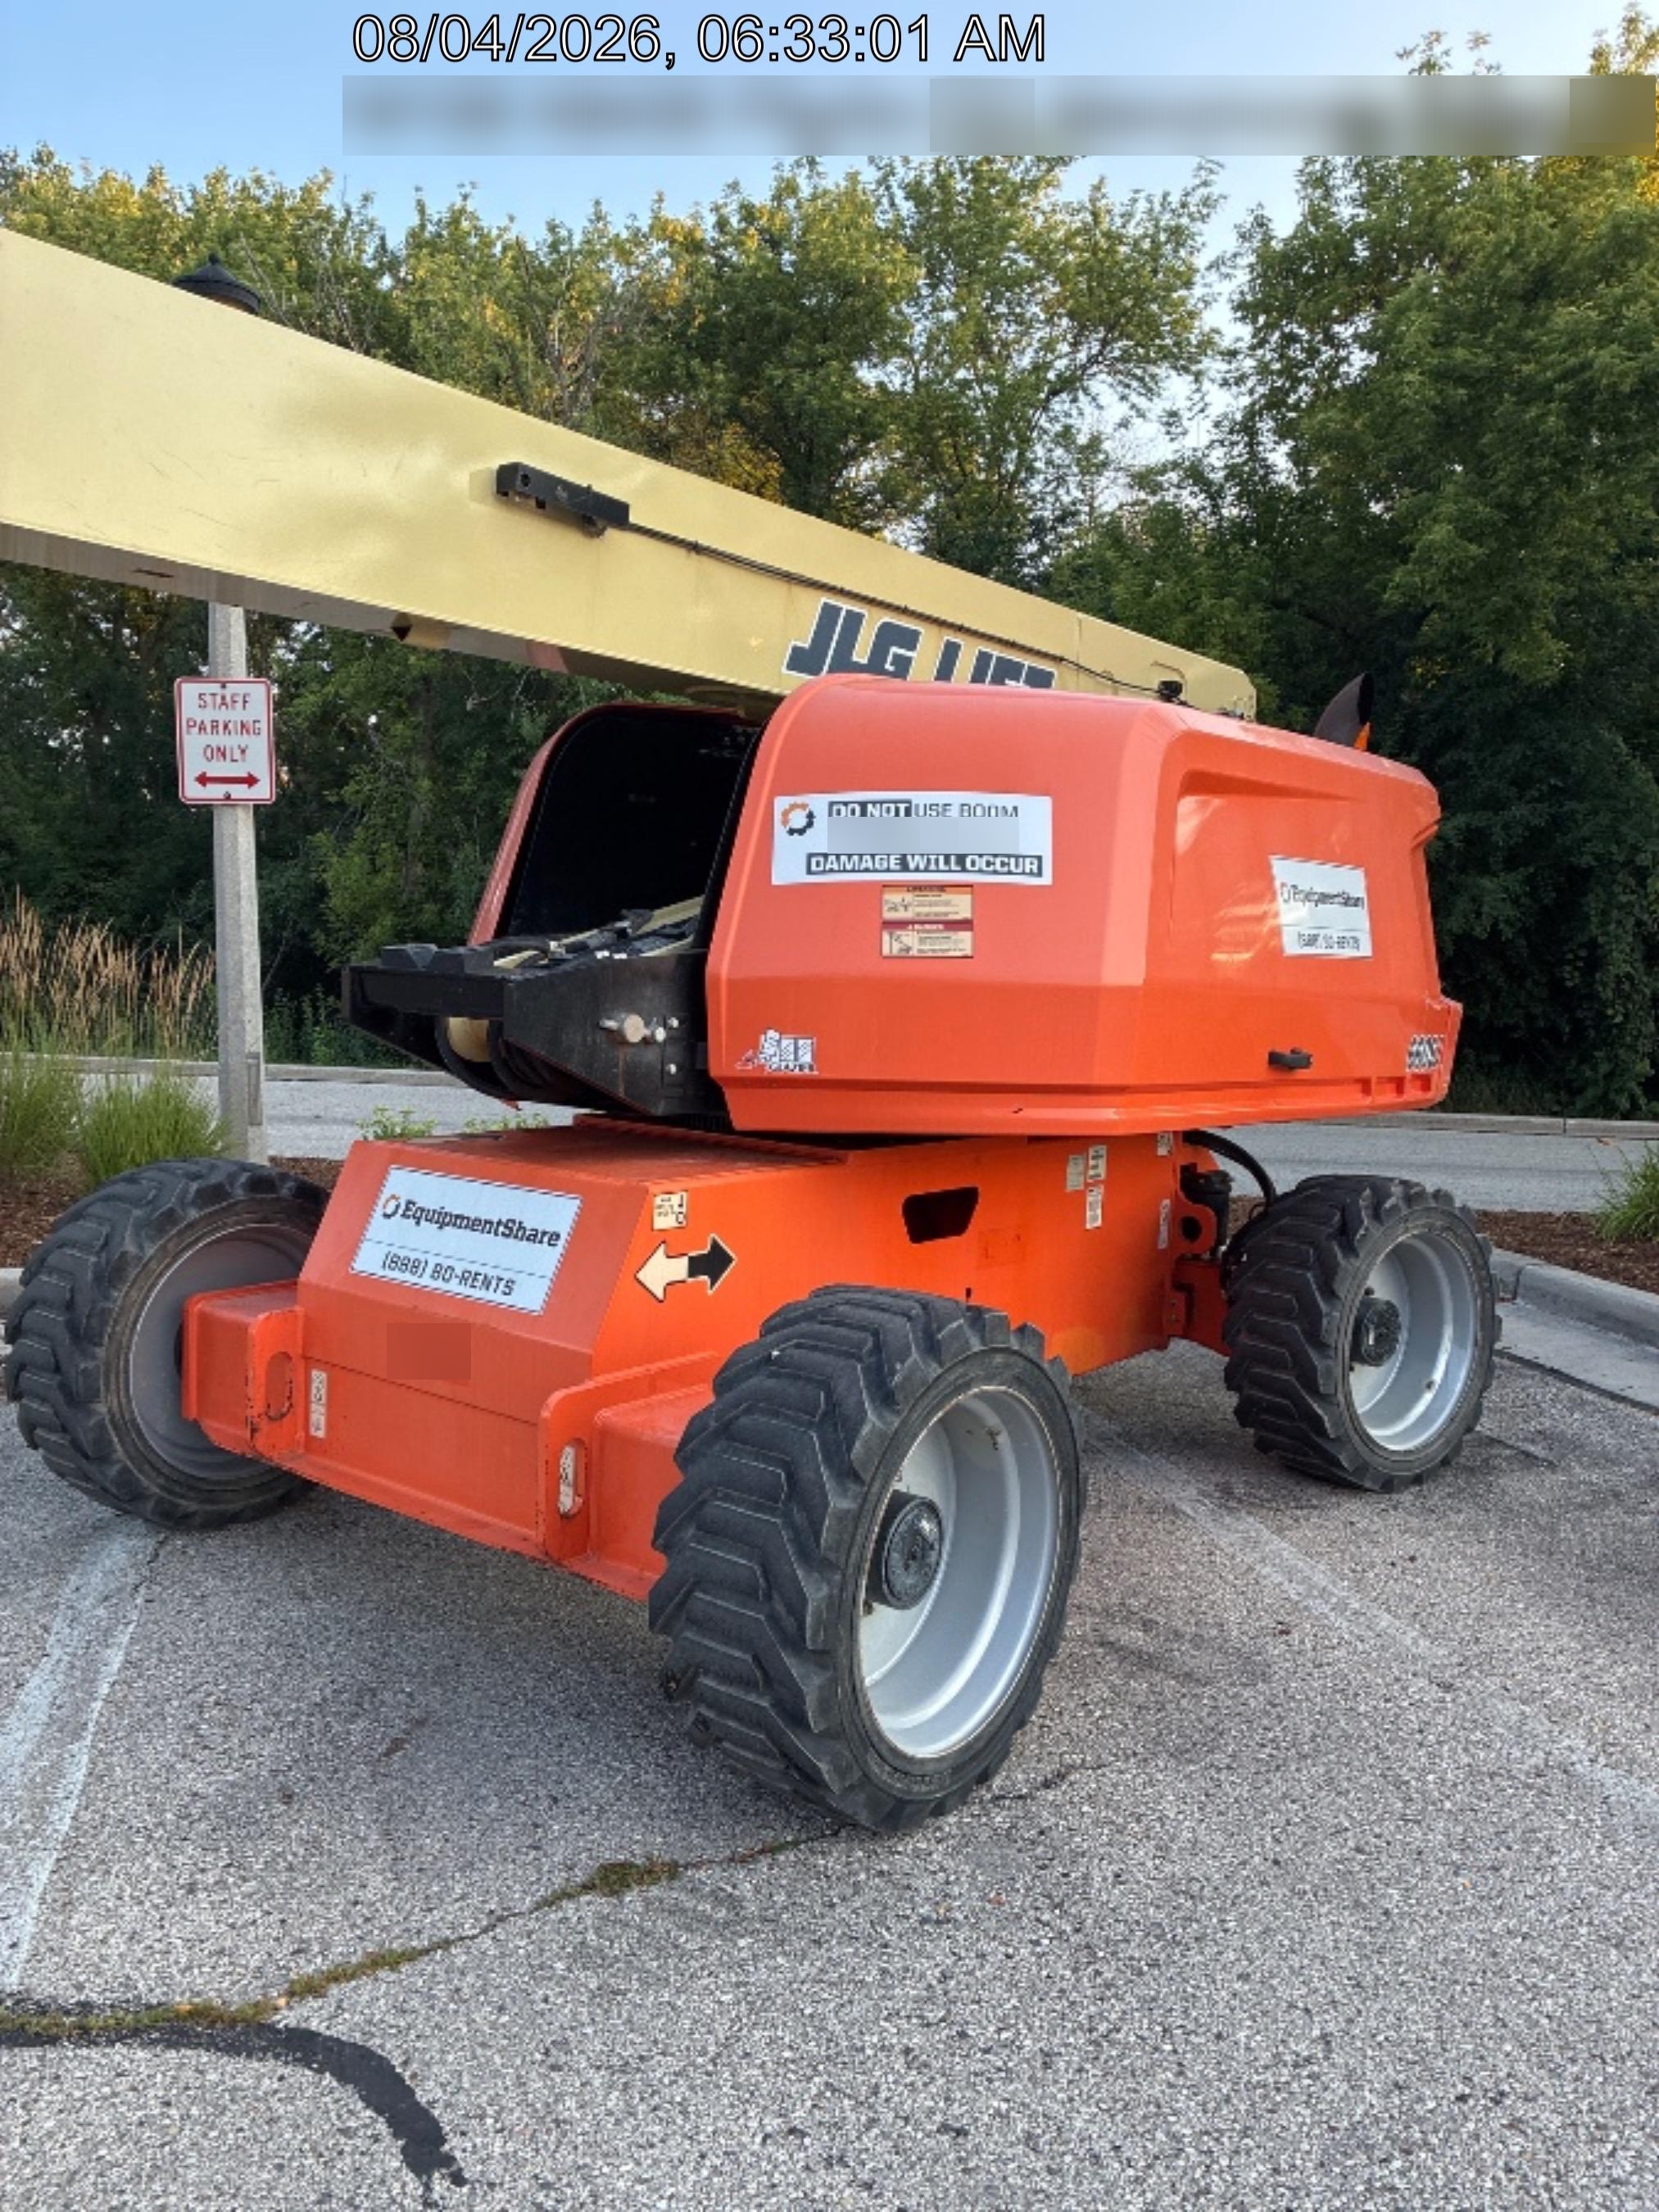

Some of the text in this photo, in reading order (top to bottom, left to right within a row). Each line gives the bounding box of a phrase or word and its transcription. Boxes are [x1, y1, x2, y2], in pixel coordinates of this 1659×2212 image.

[782, 597, 923, 680] JLG
[198, 693, 251, 710] STAFF
[186, 718, 261, 736] PARKING
[204, 744, 249, 762] ONLY
[832, 804, 1018, 818] DO NOT USE BOOM
[810, 854, 1039, 874] DAMAGE WILL OCCUR
[400, 1199, 562, 1247] EquipmentShare
[381, 1250, 516, 1297] (888) 80-RENTS
